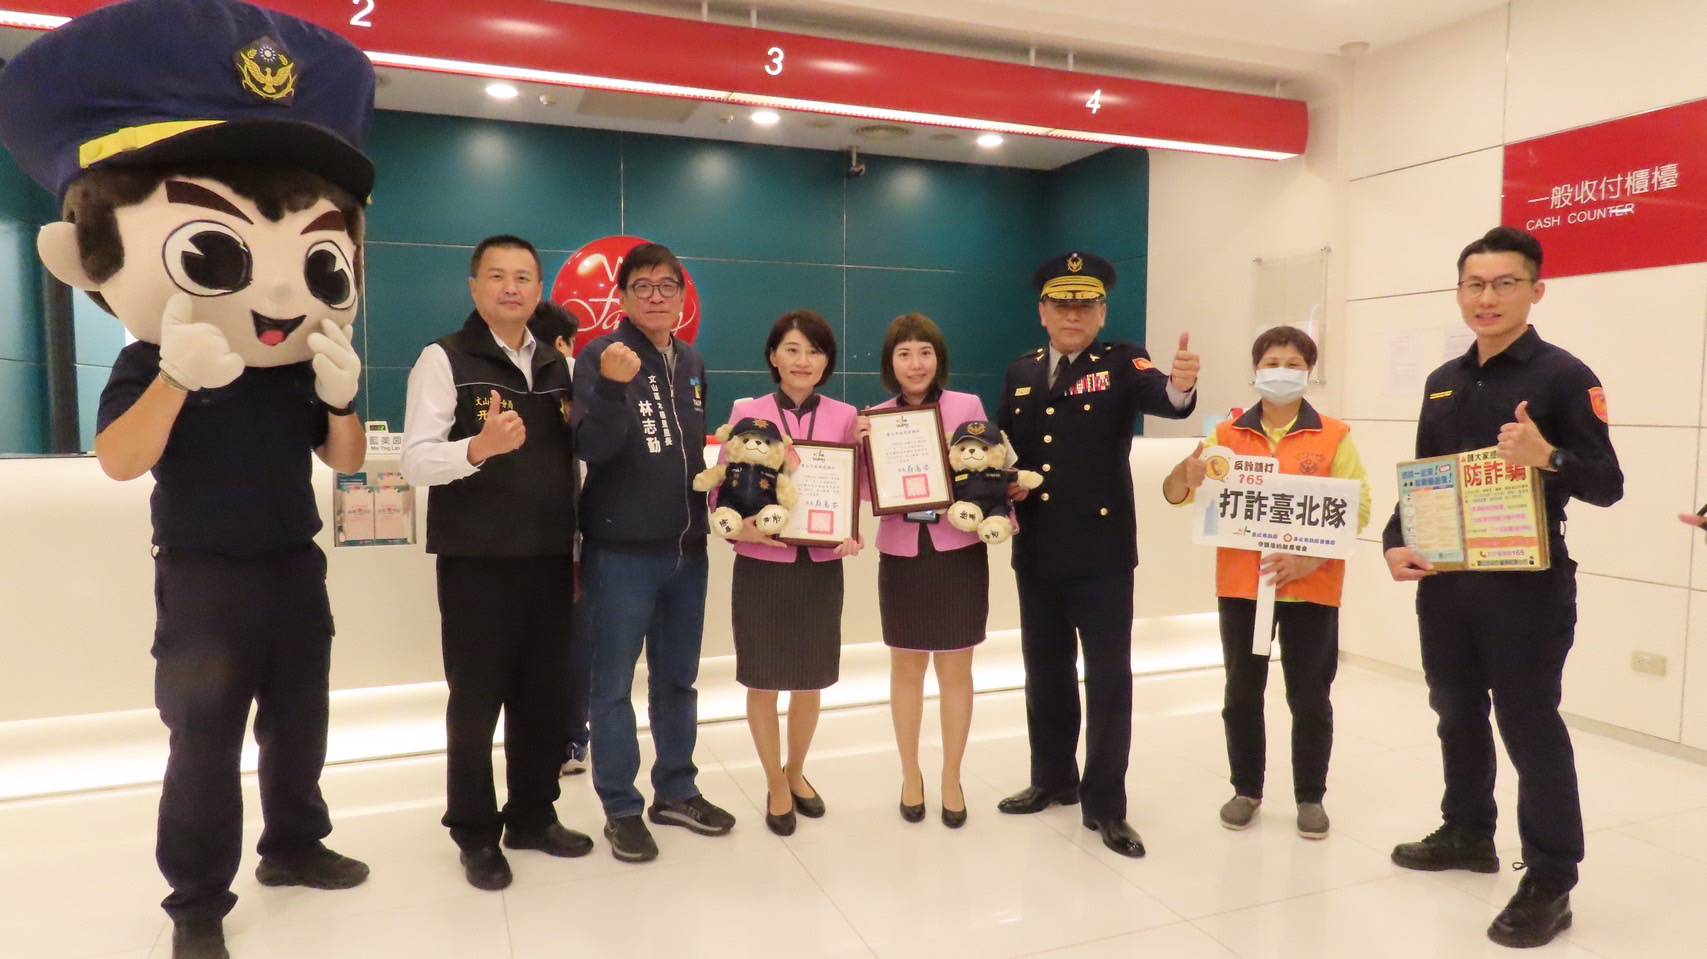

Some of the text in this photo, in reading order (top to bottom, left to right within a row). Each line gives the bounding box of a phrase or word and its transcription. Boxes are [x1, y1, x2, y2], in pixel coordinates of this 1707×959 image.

[350, 0, 374, 27] 2
[765, 47, 784, 76] 3
[1085, 89, 1102, 114] 4
[1528, 163, 1679, 210] 一般收付櫃檯
[1526, 203, 1635, 231] CASH COUNTER
[1463, 460, 1527, 488] 防詐騙
[1219, 487, 1348, 529] 打詐臺北隊
